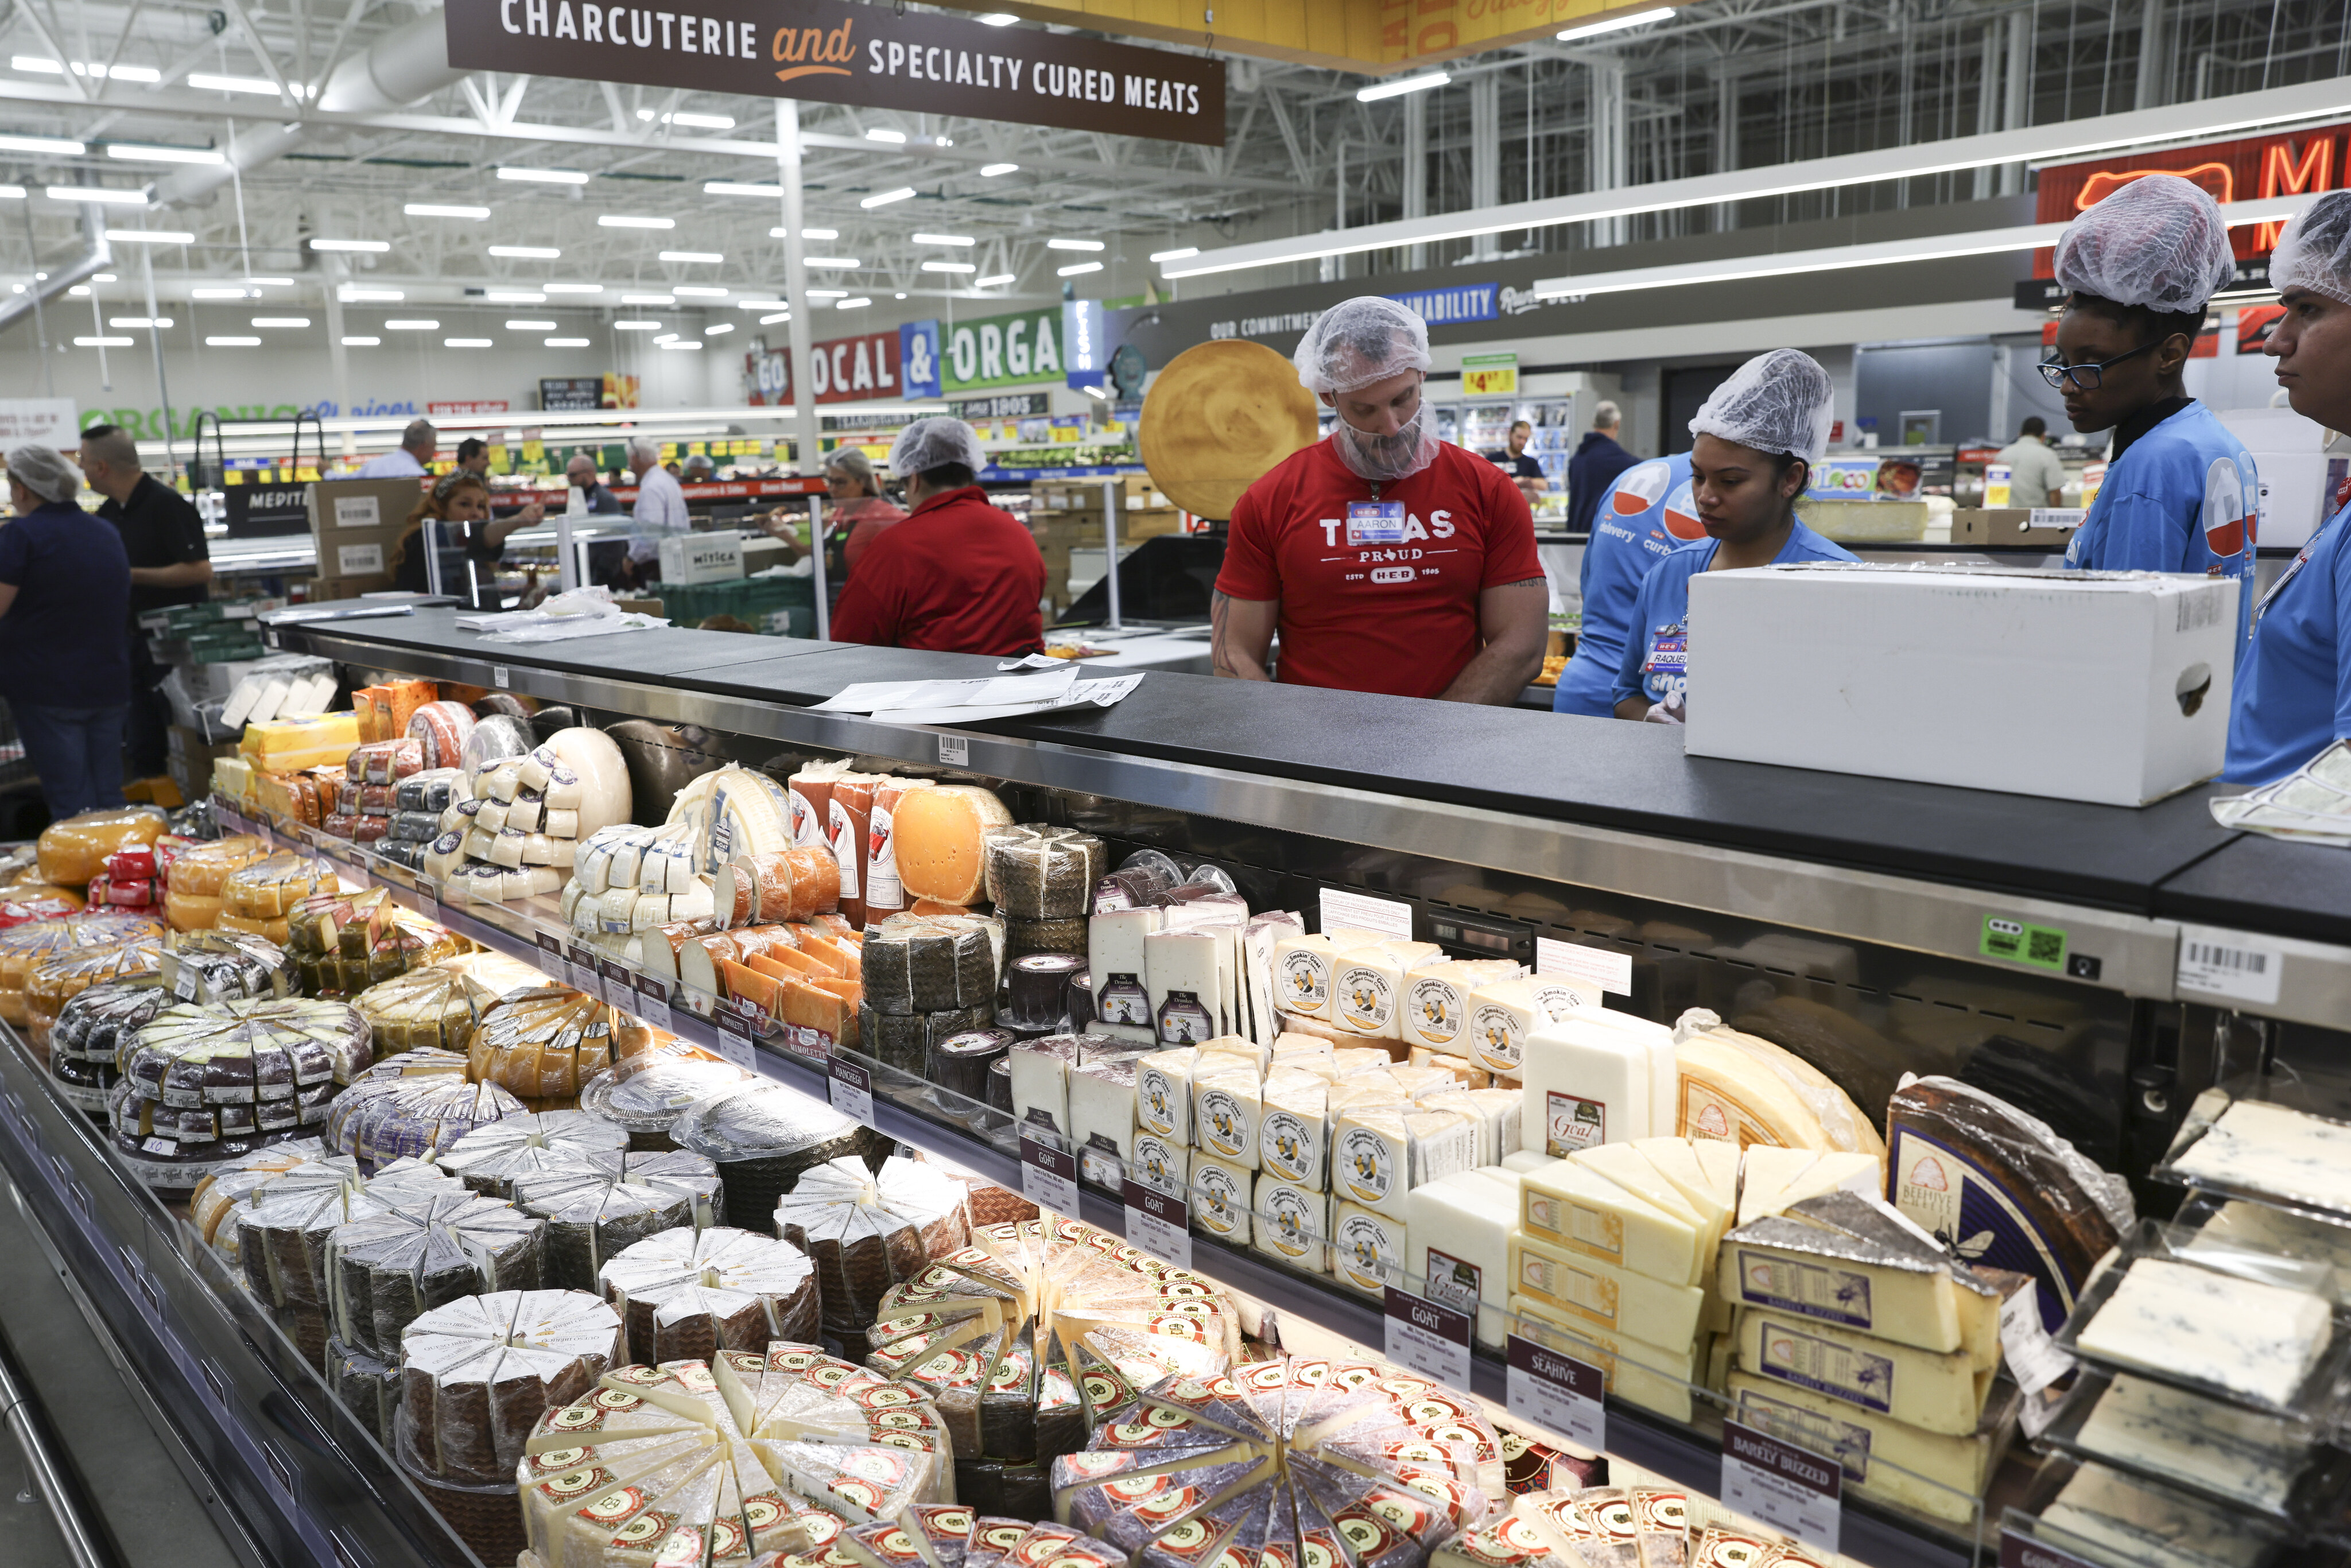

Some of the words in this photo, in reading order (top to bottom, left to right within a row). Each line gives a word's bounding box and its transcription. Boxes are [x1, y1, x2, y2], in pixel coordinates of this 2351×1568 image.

[501, 0, 756, 59] CHARCUTERIE
[772, 18, 856, 62] and
[868, 39, 1022, 90] SPECIALTY
[1033, 62, 1115, 103] CURED
[1124, 75, 1200, 115] MEATS
[1210, 320, 1236, 340] OUR
[1241, 309, 1327, 336] COMMITMEN
[1076, 300, 1092, 370] FISH
[756, 356, 786, 394] GO
[812, 339, 894, 395] OCAL
[910, 333, 933, 383] &
[953, 316, 1060, 382] ORGA
[1320, 510, 1455, 546] TAS
[1357, 519, 1397, 528] AARON
[1599, 521, 1636, 543] delivery
[1644, 539, 1671, 556] curb
[1654, 654, 1687, 664] RAQUEL
[1651, 672, 1687, 693] sho
[1330, 905, 1352, 913] EQUIPEMENT
[1390, 917, 1410, 925] STOCKAGE
[1289, 953, 1309, 961] Smokin'
[1289, 959, 1298, 971] Smoked
[1308, 961, 1318, 973] Cheese
[645, 983, 658, 996] GOUDA
[1350, 977, 1363, 985] Smoked
[1374, 982, 1383, 995] Cheese
[721, 1015, 744, 1033] MIMOLETTE
[556, 1031, 569, 1049] SMOKED
[790, 1044, 827, 1059] MIMOLETTE
[835, 1066, 862, 1085] MANCHEGO
[1038, 1147, 1054, 1155] DRUNKEN
[1039, 1152, 1055, 1168] GOAT
[1145, 1190, 1163, 1200] SMOKIN
[1903, 1185, 1953, 1205] BEEHIVE
[1145, 1197, 1163, 1213] GOAT
[453, 1309, 472, 1319] QUESO
[1412, 1306, 1440, 1330] GOAT
[1532, 1355, 1576, 1385] SEAHIVE
[1103, 1375, 1122, 1394] BALSAMIC
[1170, 1394, 1192, 1403] MERLOT
[1733, 1435, 1776, 1464] BARELY
[1781, 1452, 1829, 1487] BUZZED
[1131, 1489, 1157, 1501] MERLOT
[1164, 1501, 1189, 1517] MERLOT
[1195, 1531, 1213, 1550] MERLOT
